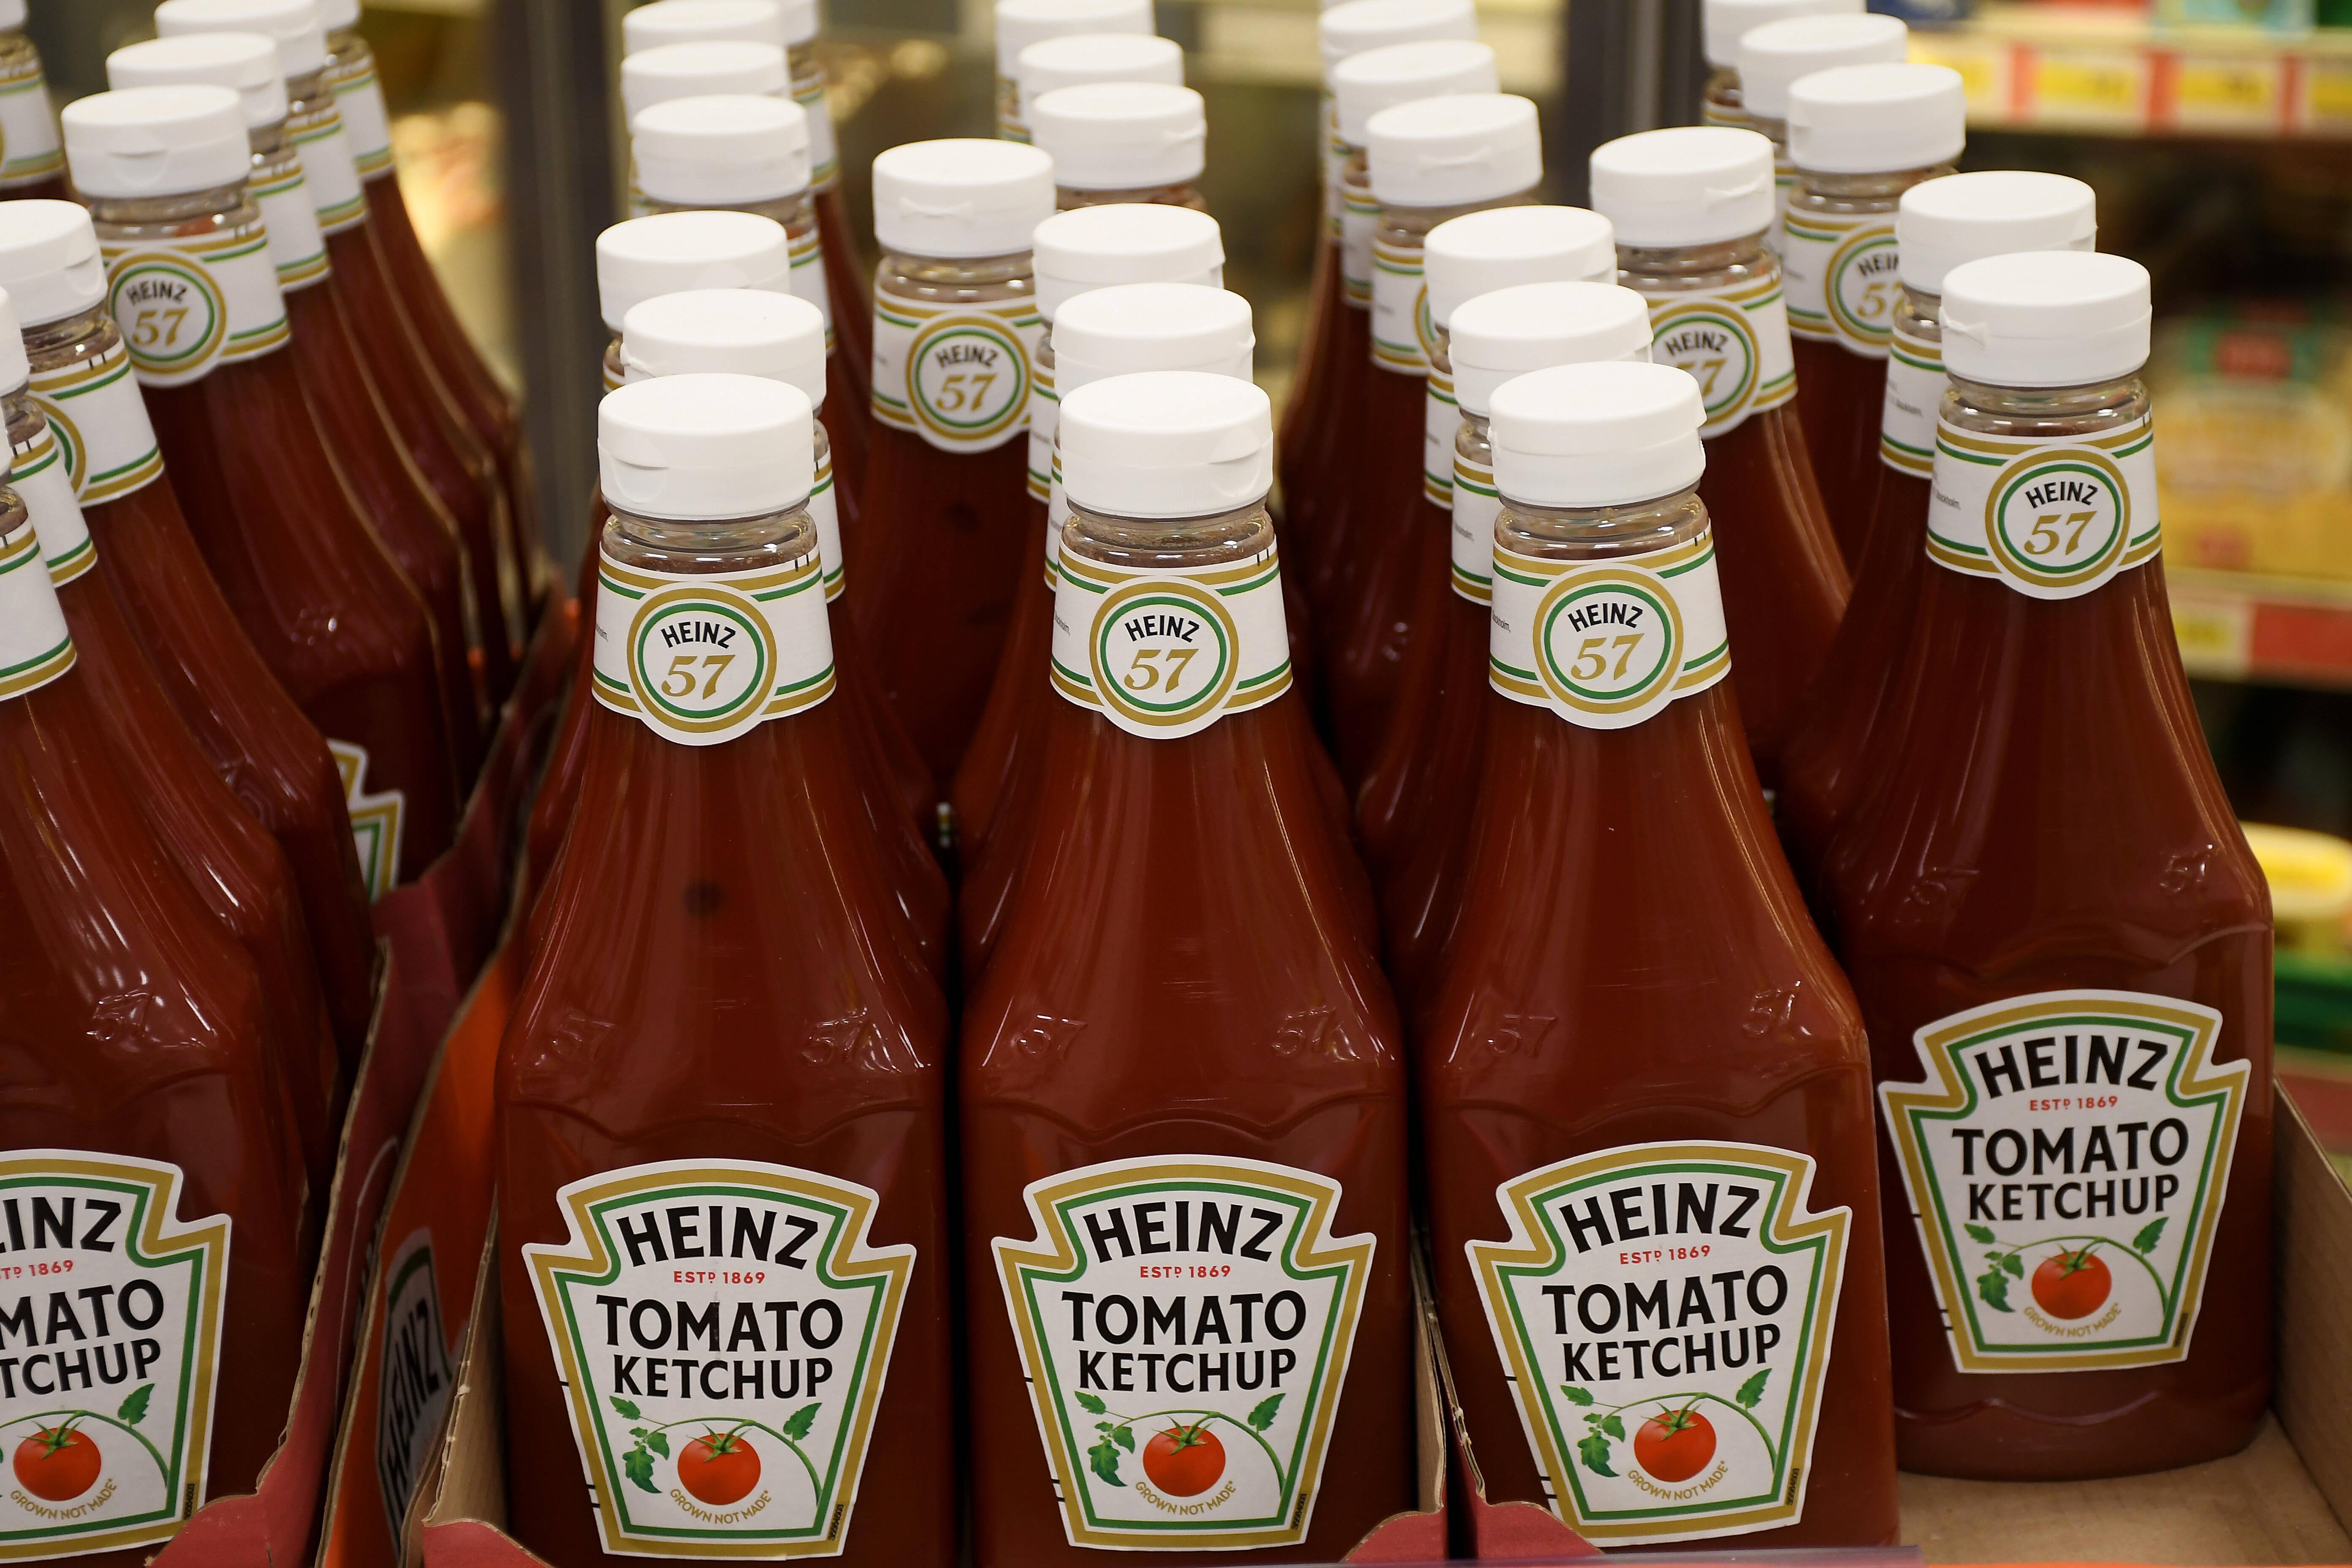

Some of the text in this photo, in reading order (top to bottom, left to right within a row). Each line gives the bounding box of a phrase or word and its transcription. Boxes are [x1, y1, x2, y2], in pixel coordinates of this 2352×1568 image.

[127, 280, 188, 306] HEINZ
[132, 308, 189, 346] 57
[1665, 331, 1729, 357] HEINZ
[935, 345, 999, 368] HEINZ
[935, 373, 997, 412] 57
[1677, 358, 1728, 399] 7
[2025, 481, 2098, 509] HEINZ
[2024, 511, 2097, 556] 57
[660, 621, 735, 648] HEINZ
[1124, 615, 1200, 643] HEINZ
[1568, 603, 1643, 632] HEINZ
[661, 654, 735, 700] 57
[1124, 648, 1198, 693] 57
[1571, 633, 1644, 681] 57
[1017, 1014, 1088, 1063] 57
[1487, 1015, 1557, 1059] 57
[1975, 1035, 2168, 1099] HEINZ
[2078, 1096, 2118, 1110] 1869
[1952, 1118, 2189, 1176] TOMATO
[1559, 1183, 1759, 1252] HEINZ
[1969, 1174, 2179, 1221] KETCHUP
[0, 1197, 121, 1253] INZ
[616, 1206, 818, 1269] HEINZ
[1083, 1201, 1283, 1263] HEINZ
[28, 1260, 74, 1277] 1869
[1189, 1265, 1231, 1278] 1869
[1669, 1245, 1711, 1260] 1869
[723, 1272, 765, 1285] 1869
[1062, 1290, 1306, 1345] TOMATO
[1542, 1265, 1788, 1335] TOMATO
[596, 1294, 843, 1352] TOMATO
[2024, 1307, 2065, 1336] GROWN
[2068, 1325, 2091, 1337] NOT
[1078, 1349, 1296, 1392] KETCHUP
[1563, 1324, 1780, 1382] KETCHUP
[613, 1354, 833, 1399] KETCHUP
[10, 1490, 58, 1519] GROWN
[60, 1504, 87, 1520] NOT
[1135, 1481, 1177, 1514] GROWN
[1179, 1503, 1204, 1515] NOT
[1628, 1470, 1671, 1500] GROWN
[1674, 1486, 1698, 1500] NOT
[670, 1489, 713, 1522] GROWN
[715, 1512, 739, 1524] NOT
